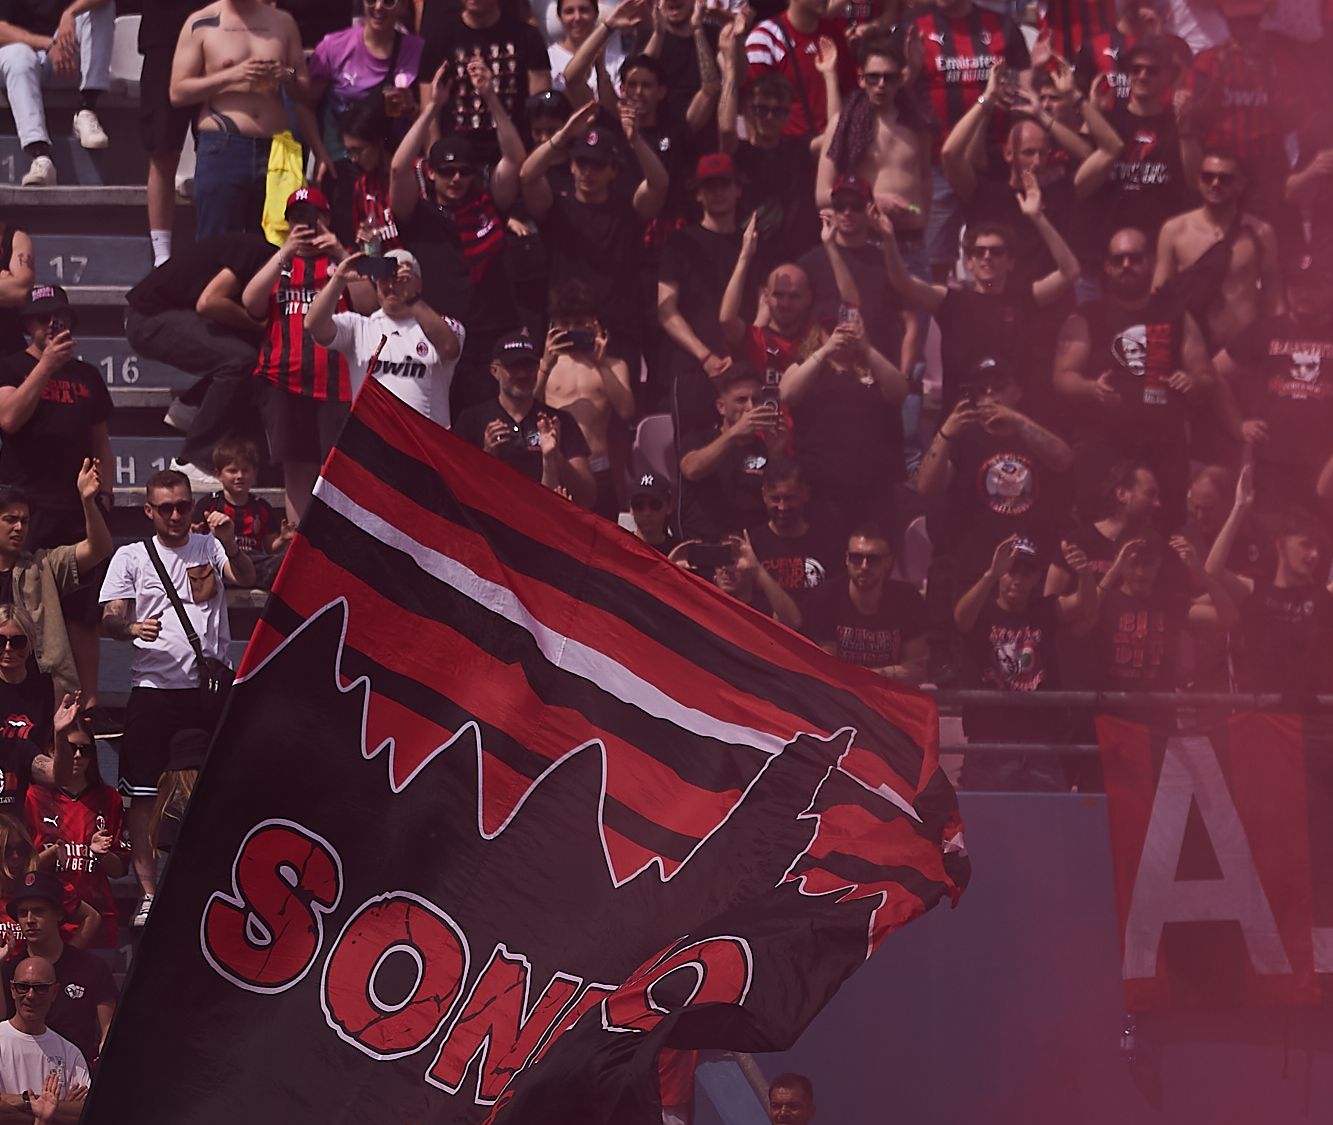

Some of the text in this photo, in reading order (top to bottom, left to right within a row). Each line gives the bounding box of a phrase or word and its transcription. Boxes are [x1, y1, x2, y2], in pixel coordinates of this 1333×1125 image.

[49, 255, 89, 284] 17
[100, 355, 141, 385] 16
[116, 455, 137, 485] H
